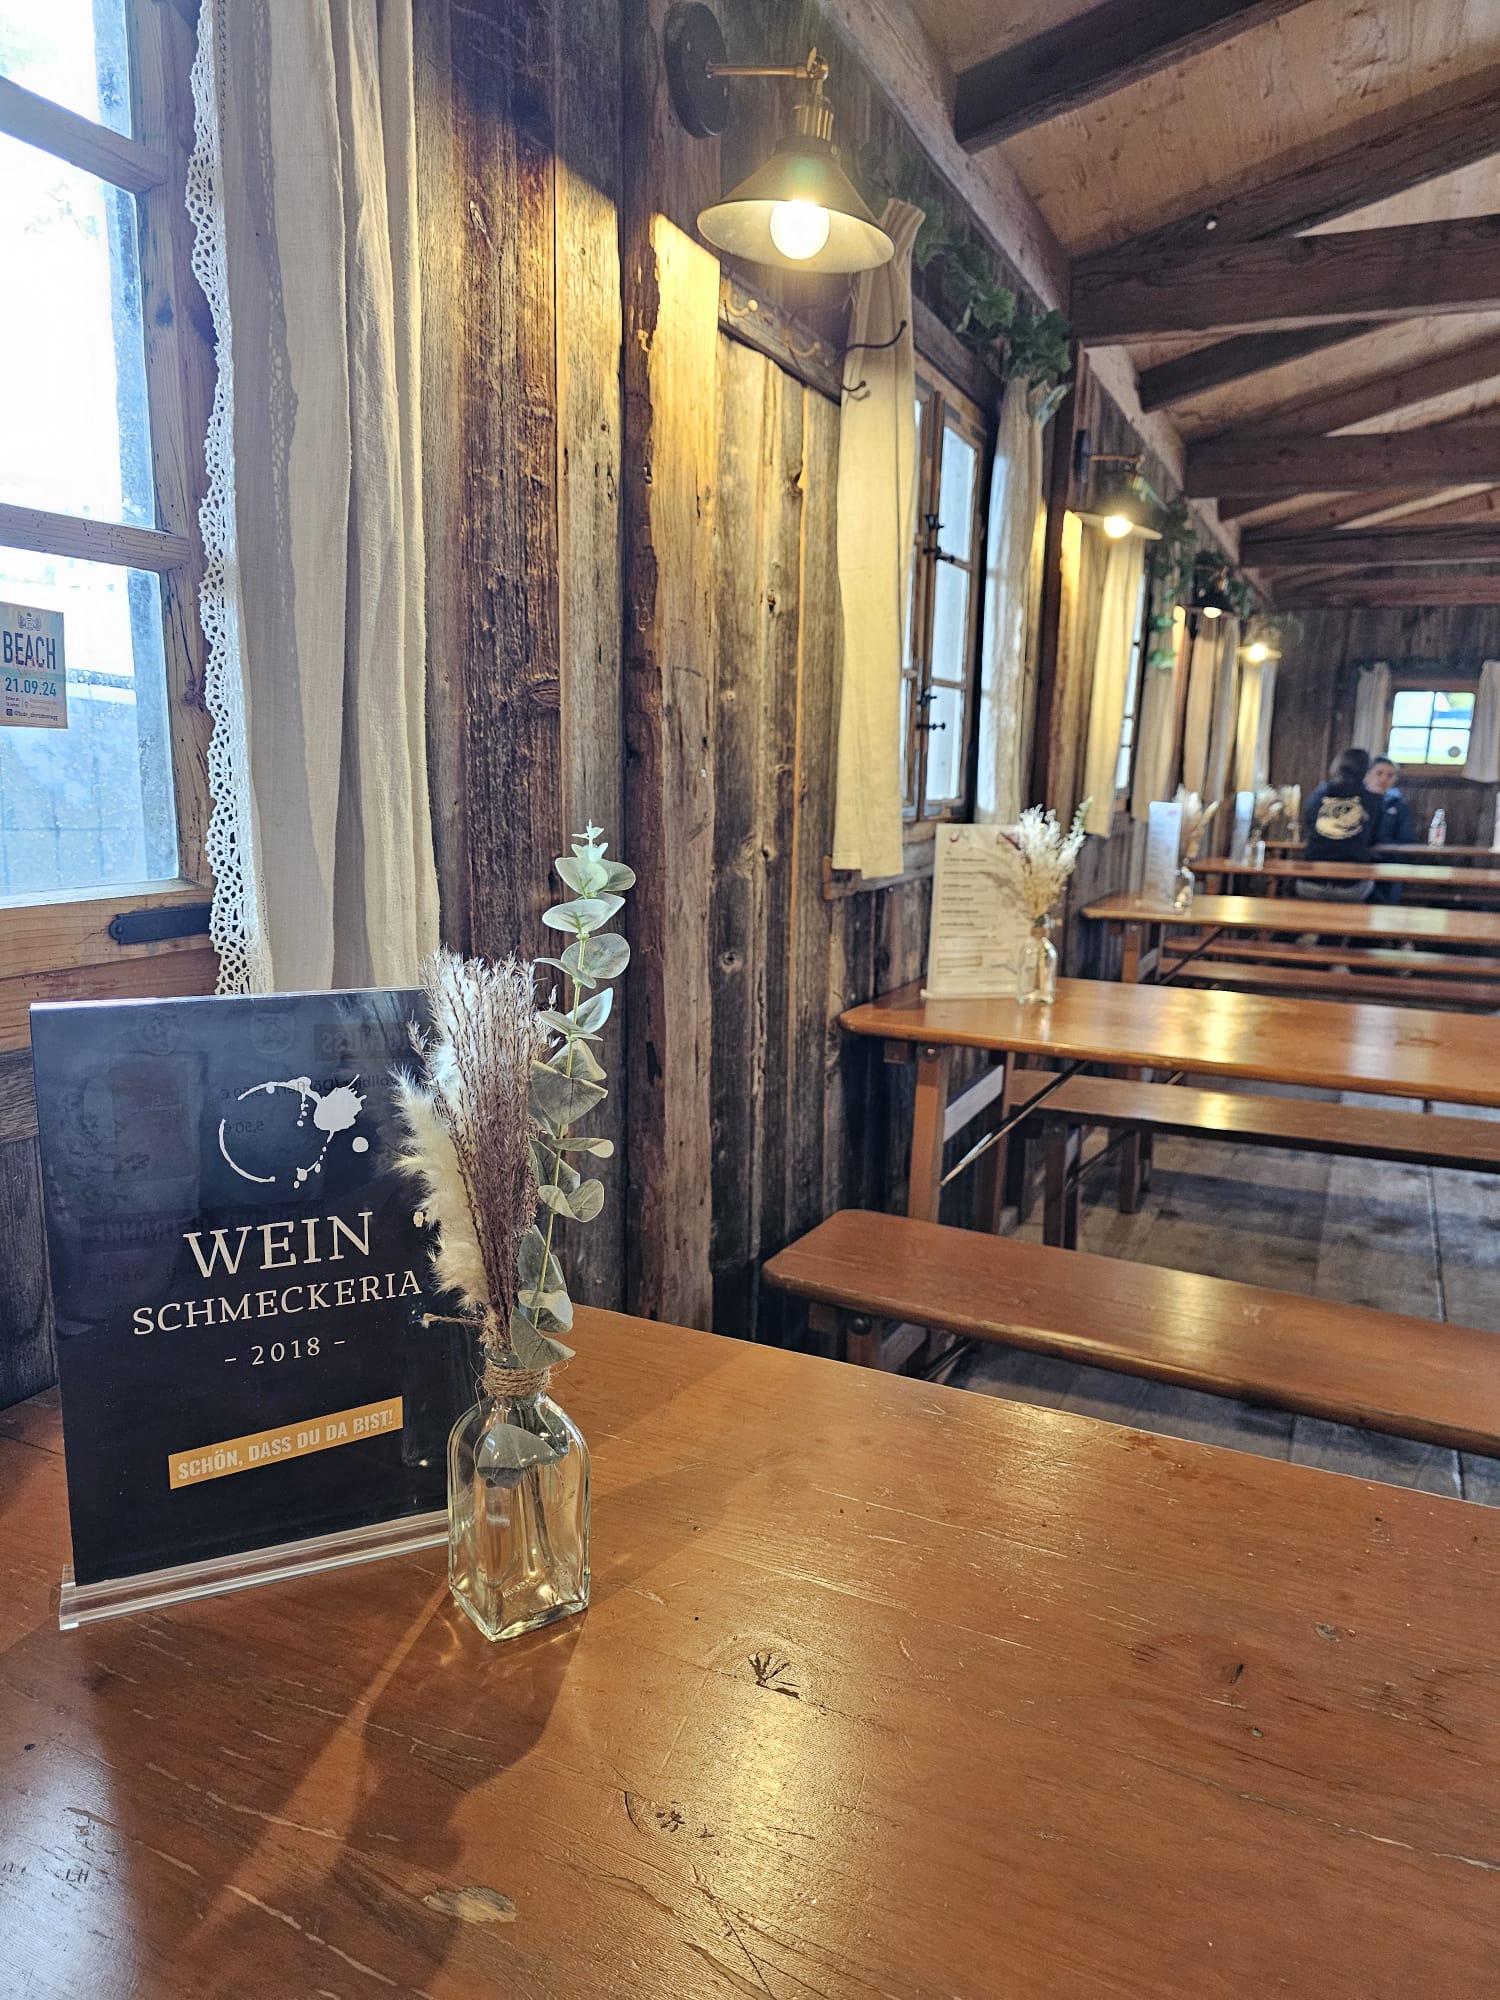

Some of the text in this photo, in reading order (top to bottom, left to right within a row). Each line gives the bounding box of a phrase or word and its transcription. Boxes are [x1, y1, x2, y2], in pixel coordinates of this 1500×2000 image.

[3, 630, 56, 670] BEACH
[5, 677, 57, 697] 21.09.24
[183, 1211, 373, 1279] WEIN
[133, 1270, 422, 1335] SCHMECKERIA
[251, 1337, 320, 1365] 2018
[178, 1409, 394, 1480] SCHÖN, DASS DU DA BIST!
